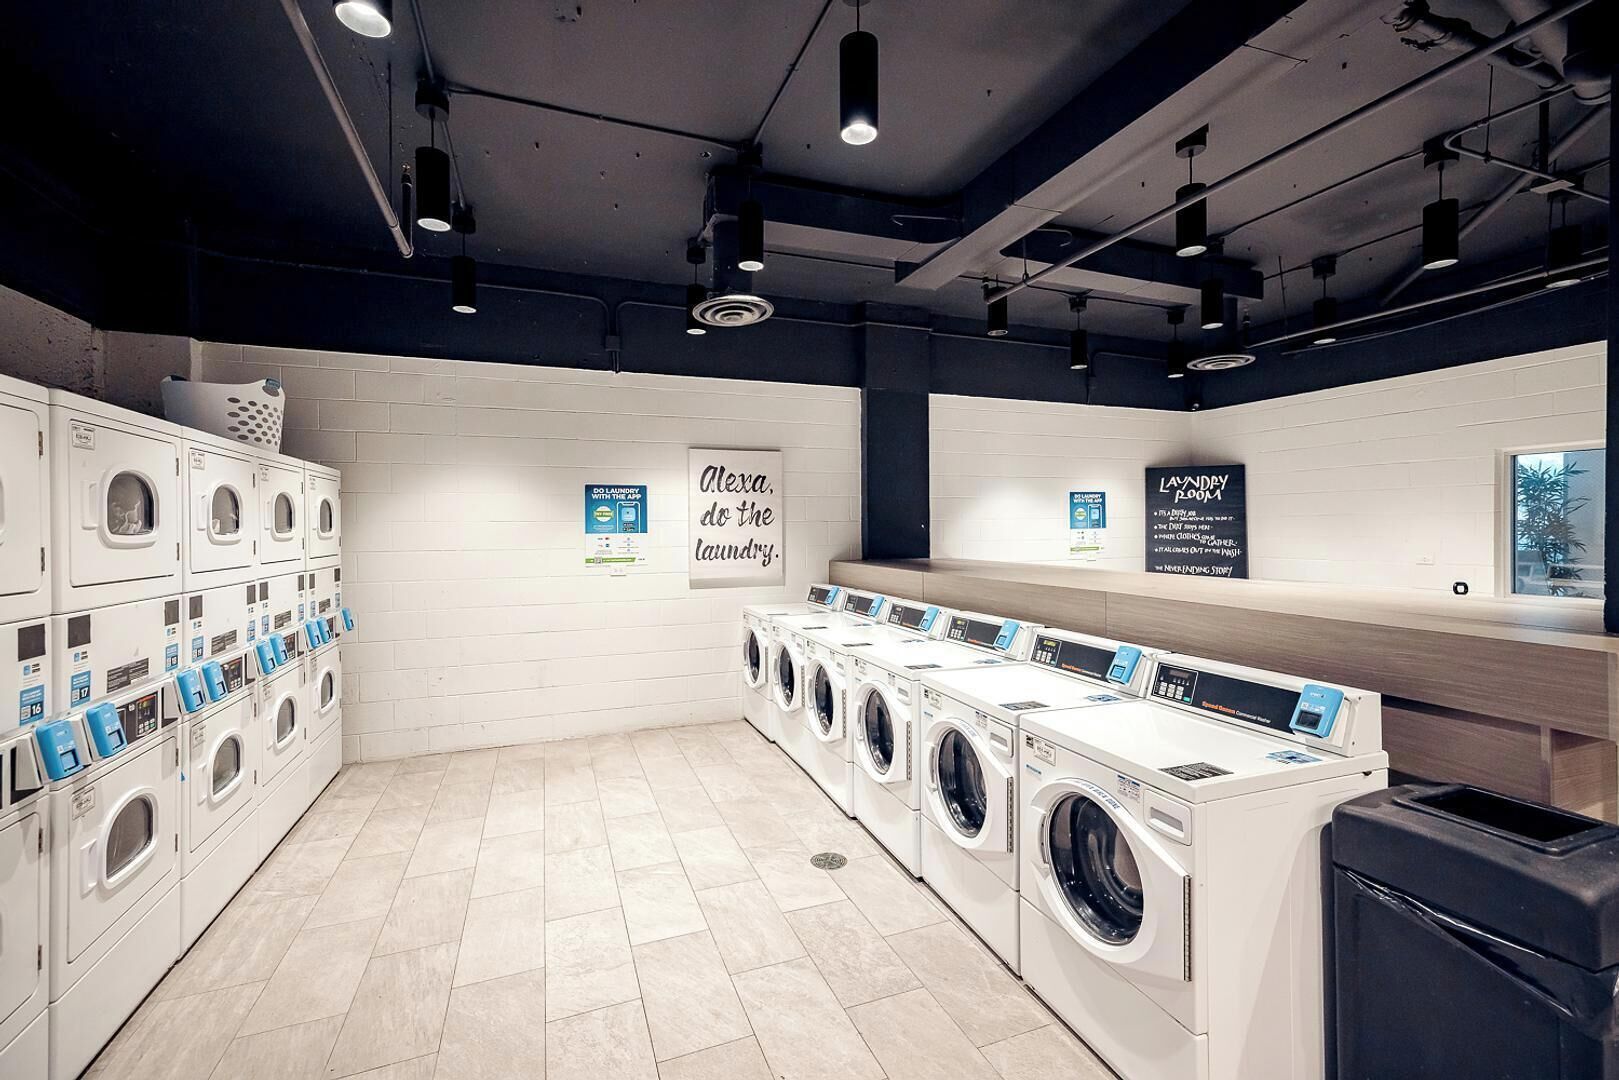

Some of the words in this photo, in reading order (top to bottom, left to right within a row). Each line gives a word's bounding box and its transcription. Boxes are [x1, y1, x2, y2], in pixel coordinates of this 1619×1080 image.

[699, 464, 774, 495] Alexa,
[1159, 474, 1229, 493] LAUNDRY
[1174, 489, 1222, 503] ROOM
[699, 501, 732, 527] do
[736, 500, 775, 527] the
[1176, 532, 1201, 541] CLOTHES
[695, 538, 779, 567] laundry.
[1189, 546, 1204, 554] OUT
[1210, 565, 1233, 577] STORY
[80, 686, 89, 698] 17
[31, 703, 42, 715] 16
